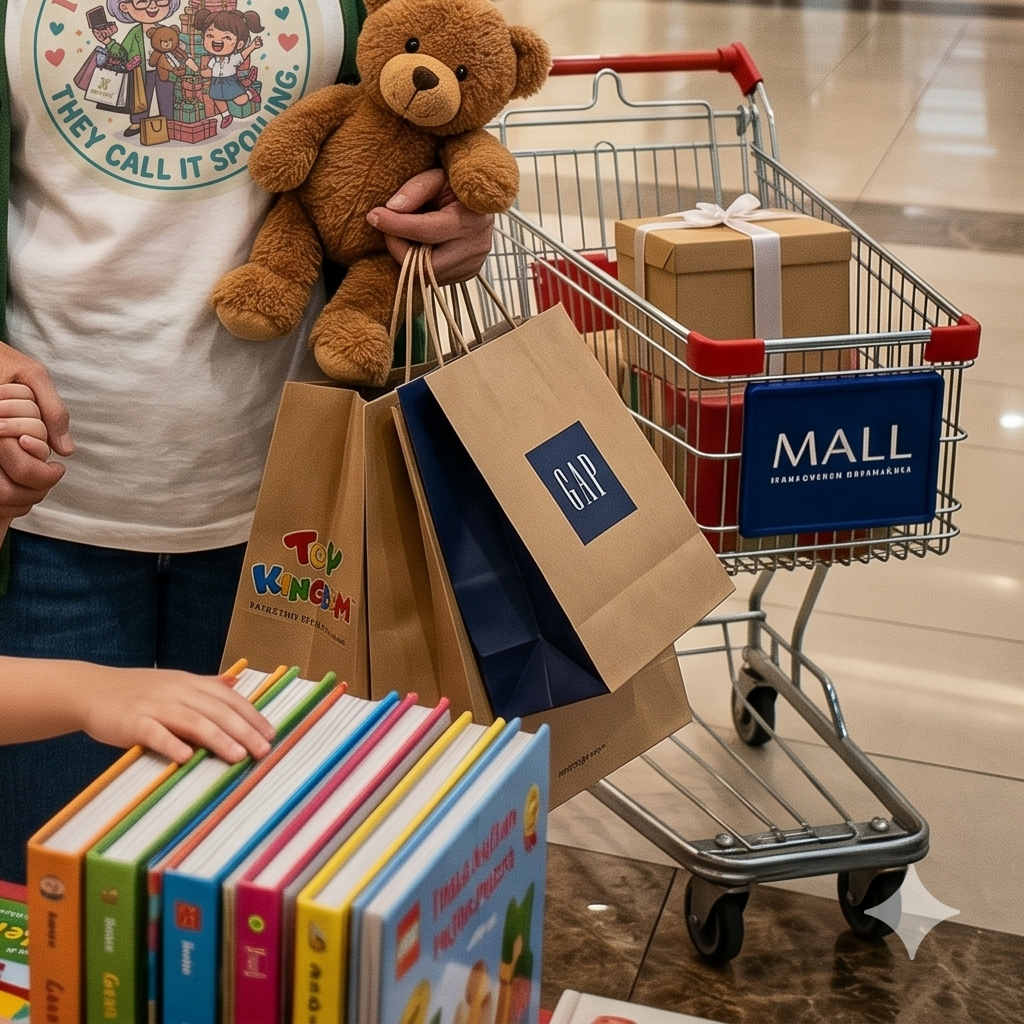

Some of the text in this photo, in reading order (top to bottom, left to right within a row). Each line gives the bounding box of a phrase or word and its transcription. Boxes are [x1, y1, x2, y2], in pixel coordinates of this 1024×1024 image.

[51, 83, 106, 149] THEY
[105, 143, 171, 181] CALL
[180, 155, 203, 180] IT
[773, 424, 912, 468] MALL
[553, 453, 607, 511] GAP
[282, 529, 343, 576] TOY
